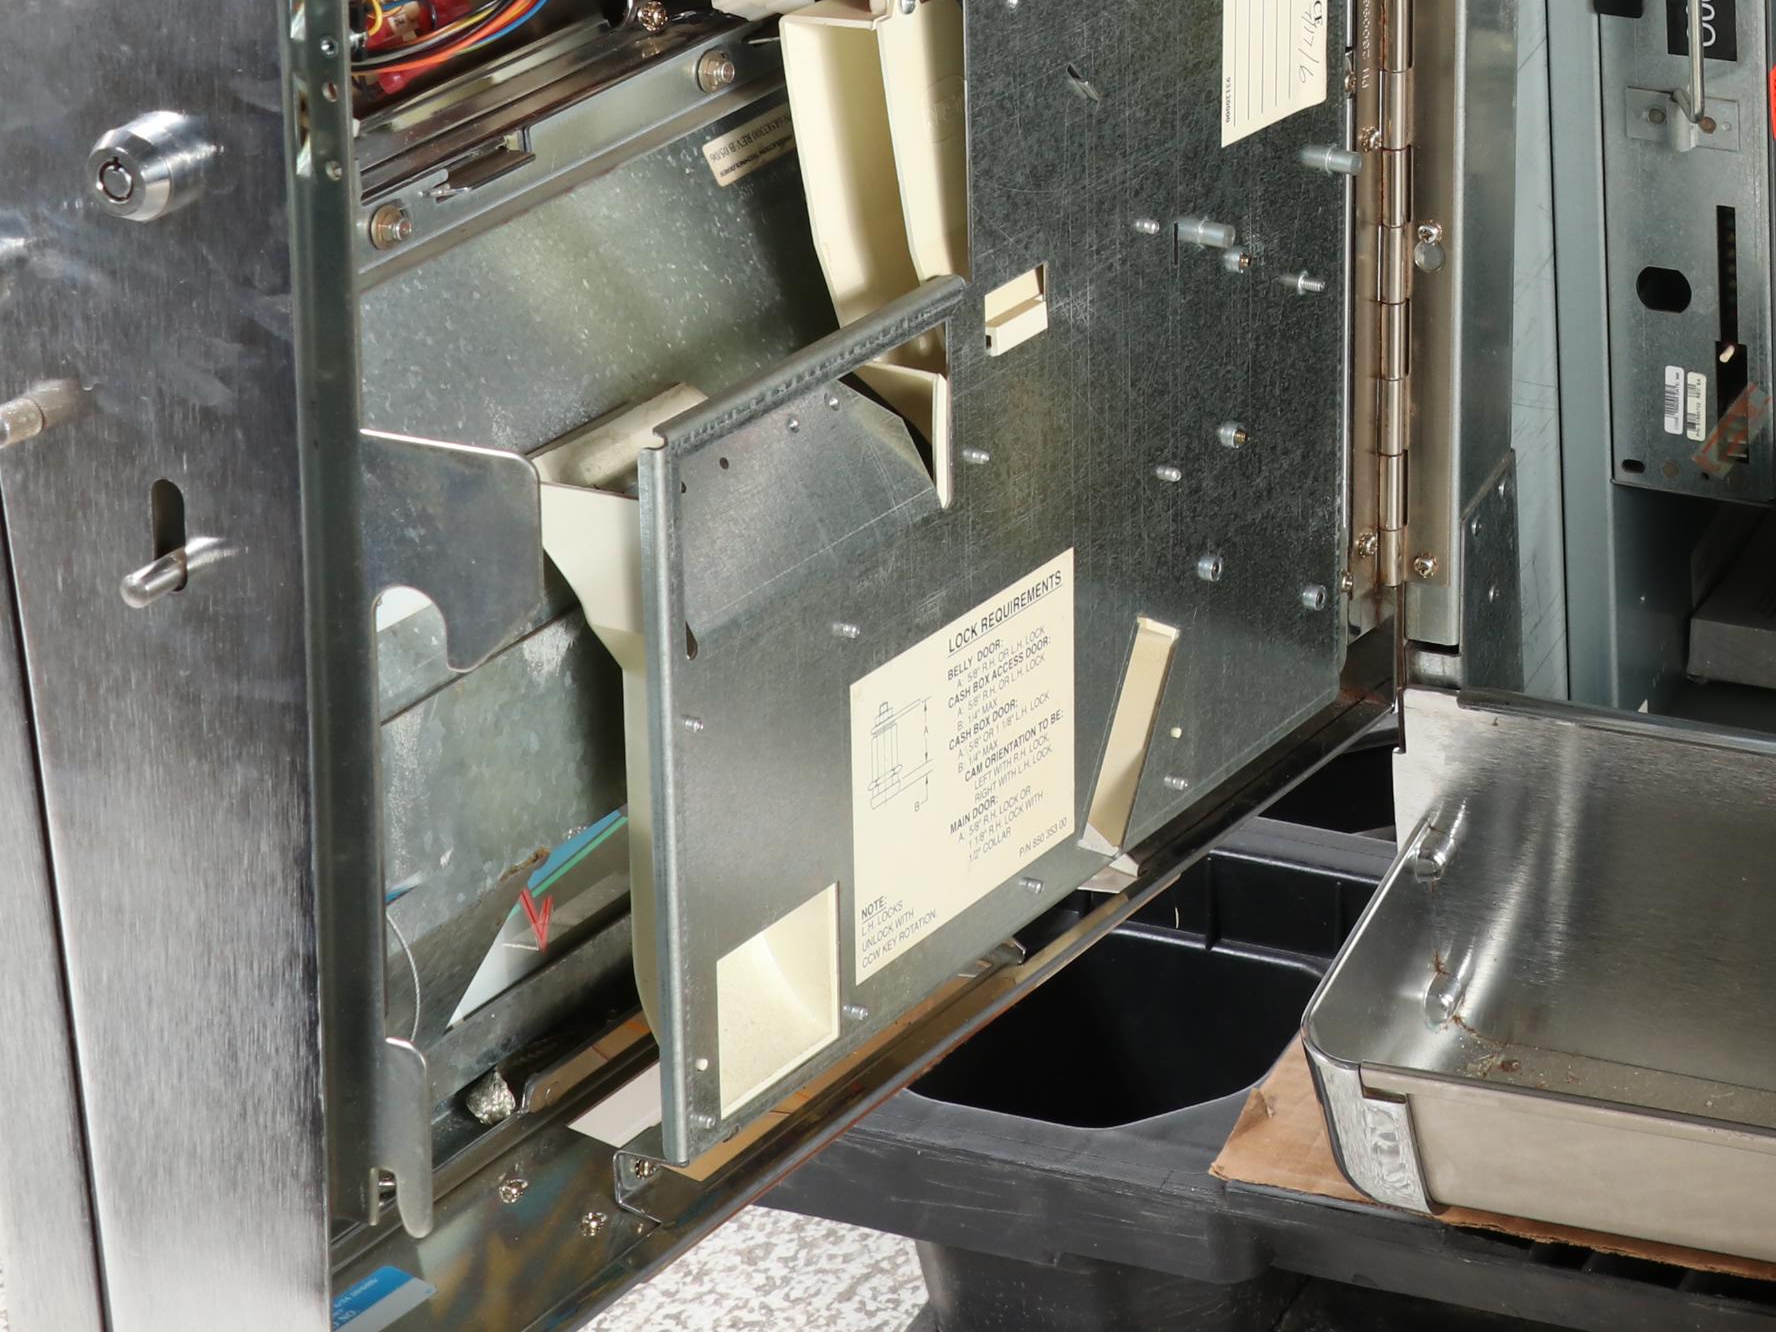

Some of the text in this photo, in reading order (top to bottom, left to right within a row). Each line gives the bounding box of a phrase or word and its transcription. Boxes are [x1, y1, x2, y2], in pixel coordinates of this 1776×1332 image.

[949, 569, 1061, 652] LOCK REQUIREMENTS
[1026, 624, 1043, 644] LOCK
[948, 636, 1003, 680] BELLY DOOR:
[948, 634, 1050, 708] CASH BOX ACCESS DOOR:
[999, 675, 1008, 690] OR
[1026, 652, 1044, 672] LOCK
[949, 697, 1017, 750] CASH BOX DOOR:
[982, 697, 997, 715] MAX
[983, 728, 992, 742] OR
[1031, 690, 1048, 710] LOCK
[965, 707, 1062, 782] CAM ORIENTATION TO BE:
[974, 770, 991, 790] LEFT
[993, 757, 1011, 776] WITH
[1029, 732, 1047, 752] LOCK
[983, 739, 997, 756] MAX
[975, 781, 996, 803] RIGHT
[999, 767, 1015, 787] WITH
[1032, 743, 1051, 764] LOCK
[951, 793, 997, 833] MAIN DOOR:
[999, 793, 1017, 814] LOCK
[1020, 785, 1029, 800] OR
[1005, 804, 1022, 824] LOCK
[1026, 790, 1042, 810] WITH
[983, 826, 1010, 853] COLLAR
[1059, 817, 1066, 829] 00
[862, 893, 886, 919] NOTE:
[878, 899, 902, 925] LOCKS
[863, 907, 913, 952] UNLOCK WITH
[863, 908, 935, 968] CCW KEY ROTATION
